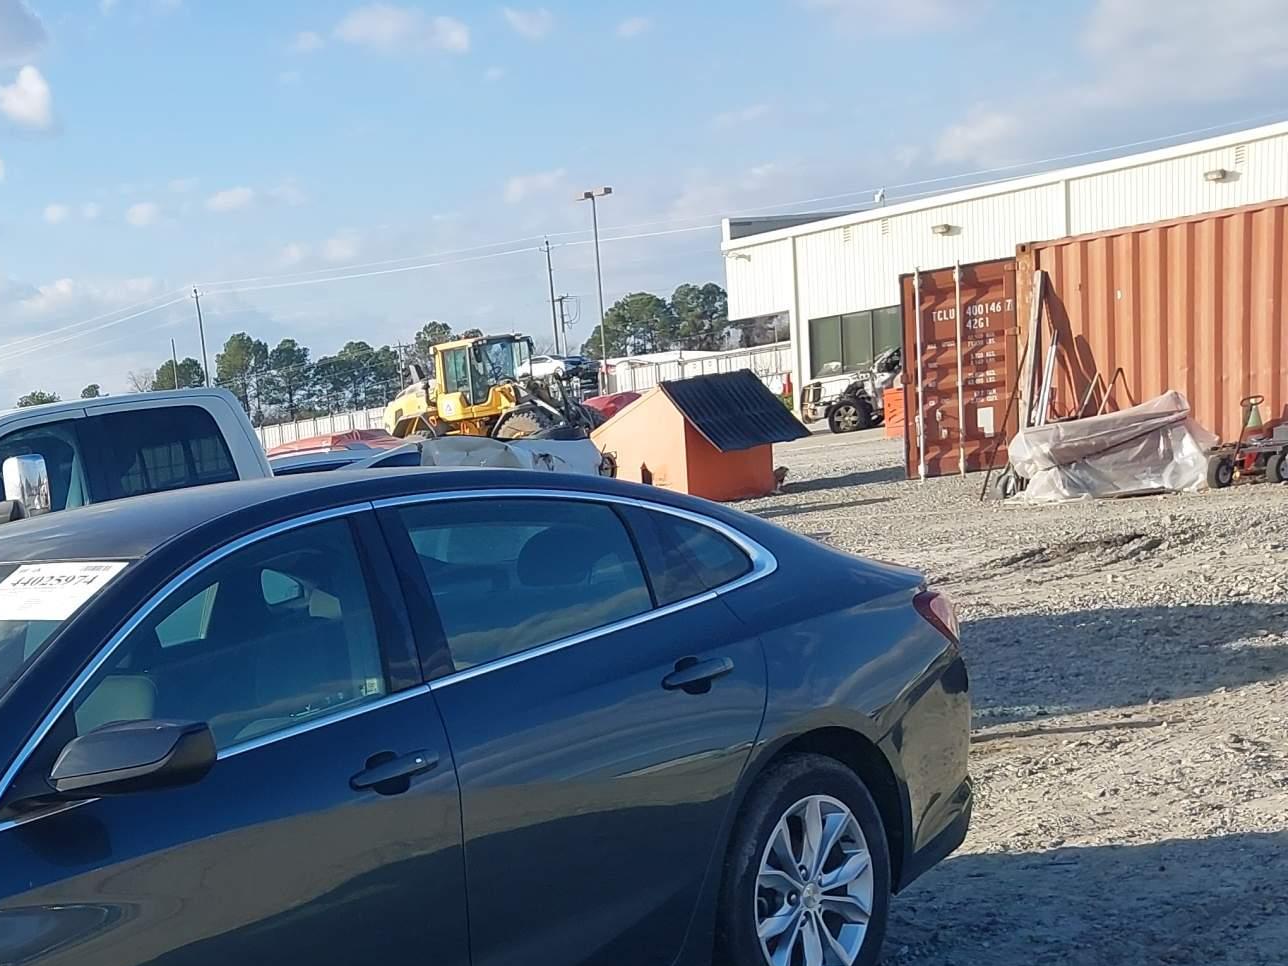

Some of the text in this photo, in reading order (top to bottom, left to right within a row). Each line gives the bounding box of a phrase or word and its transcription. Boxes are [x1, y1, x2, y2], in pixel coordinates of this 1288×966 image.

[932, 308, 955, 322] TCLU
[966, 301, 1002, 317] 400146
[966, 317, 990, 330] 42G1
[10, 574, 100, 587] 44025974
